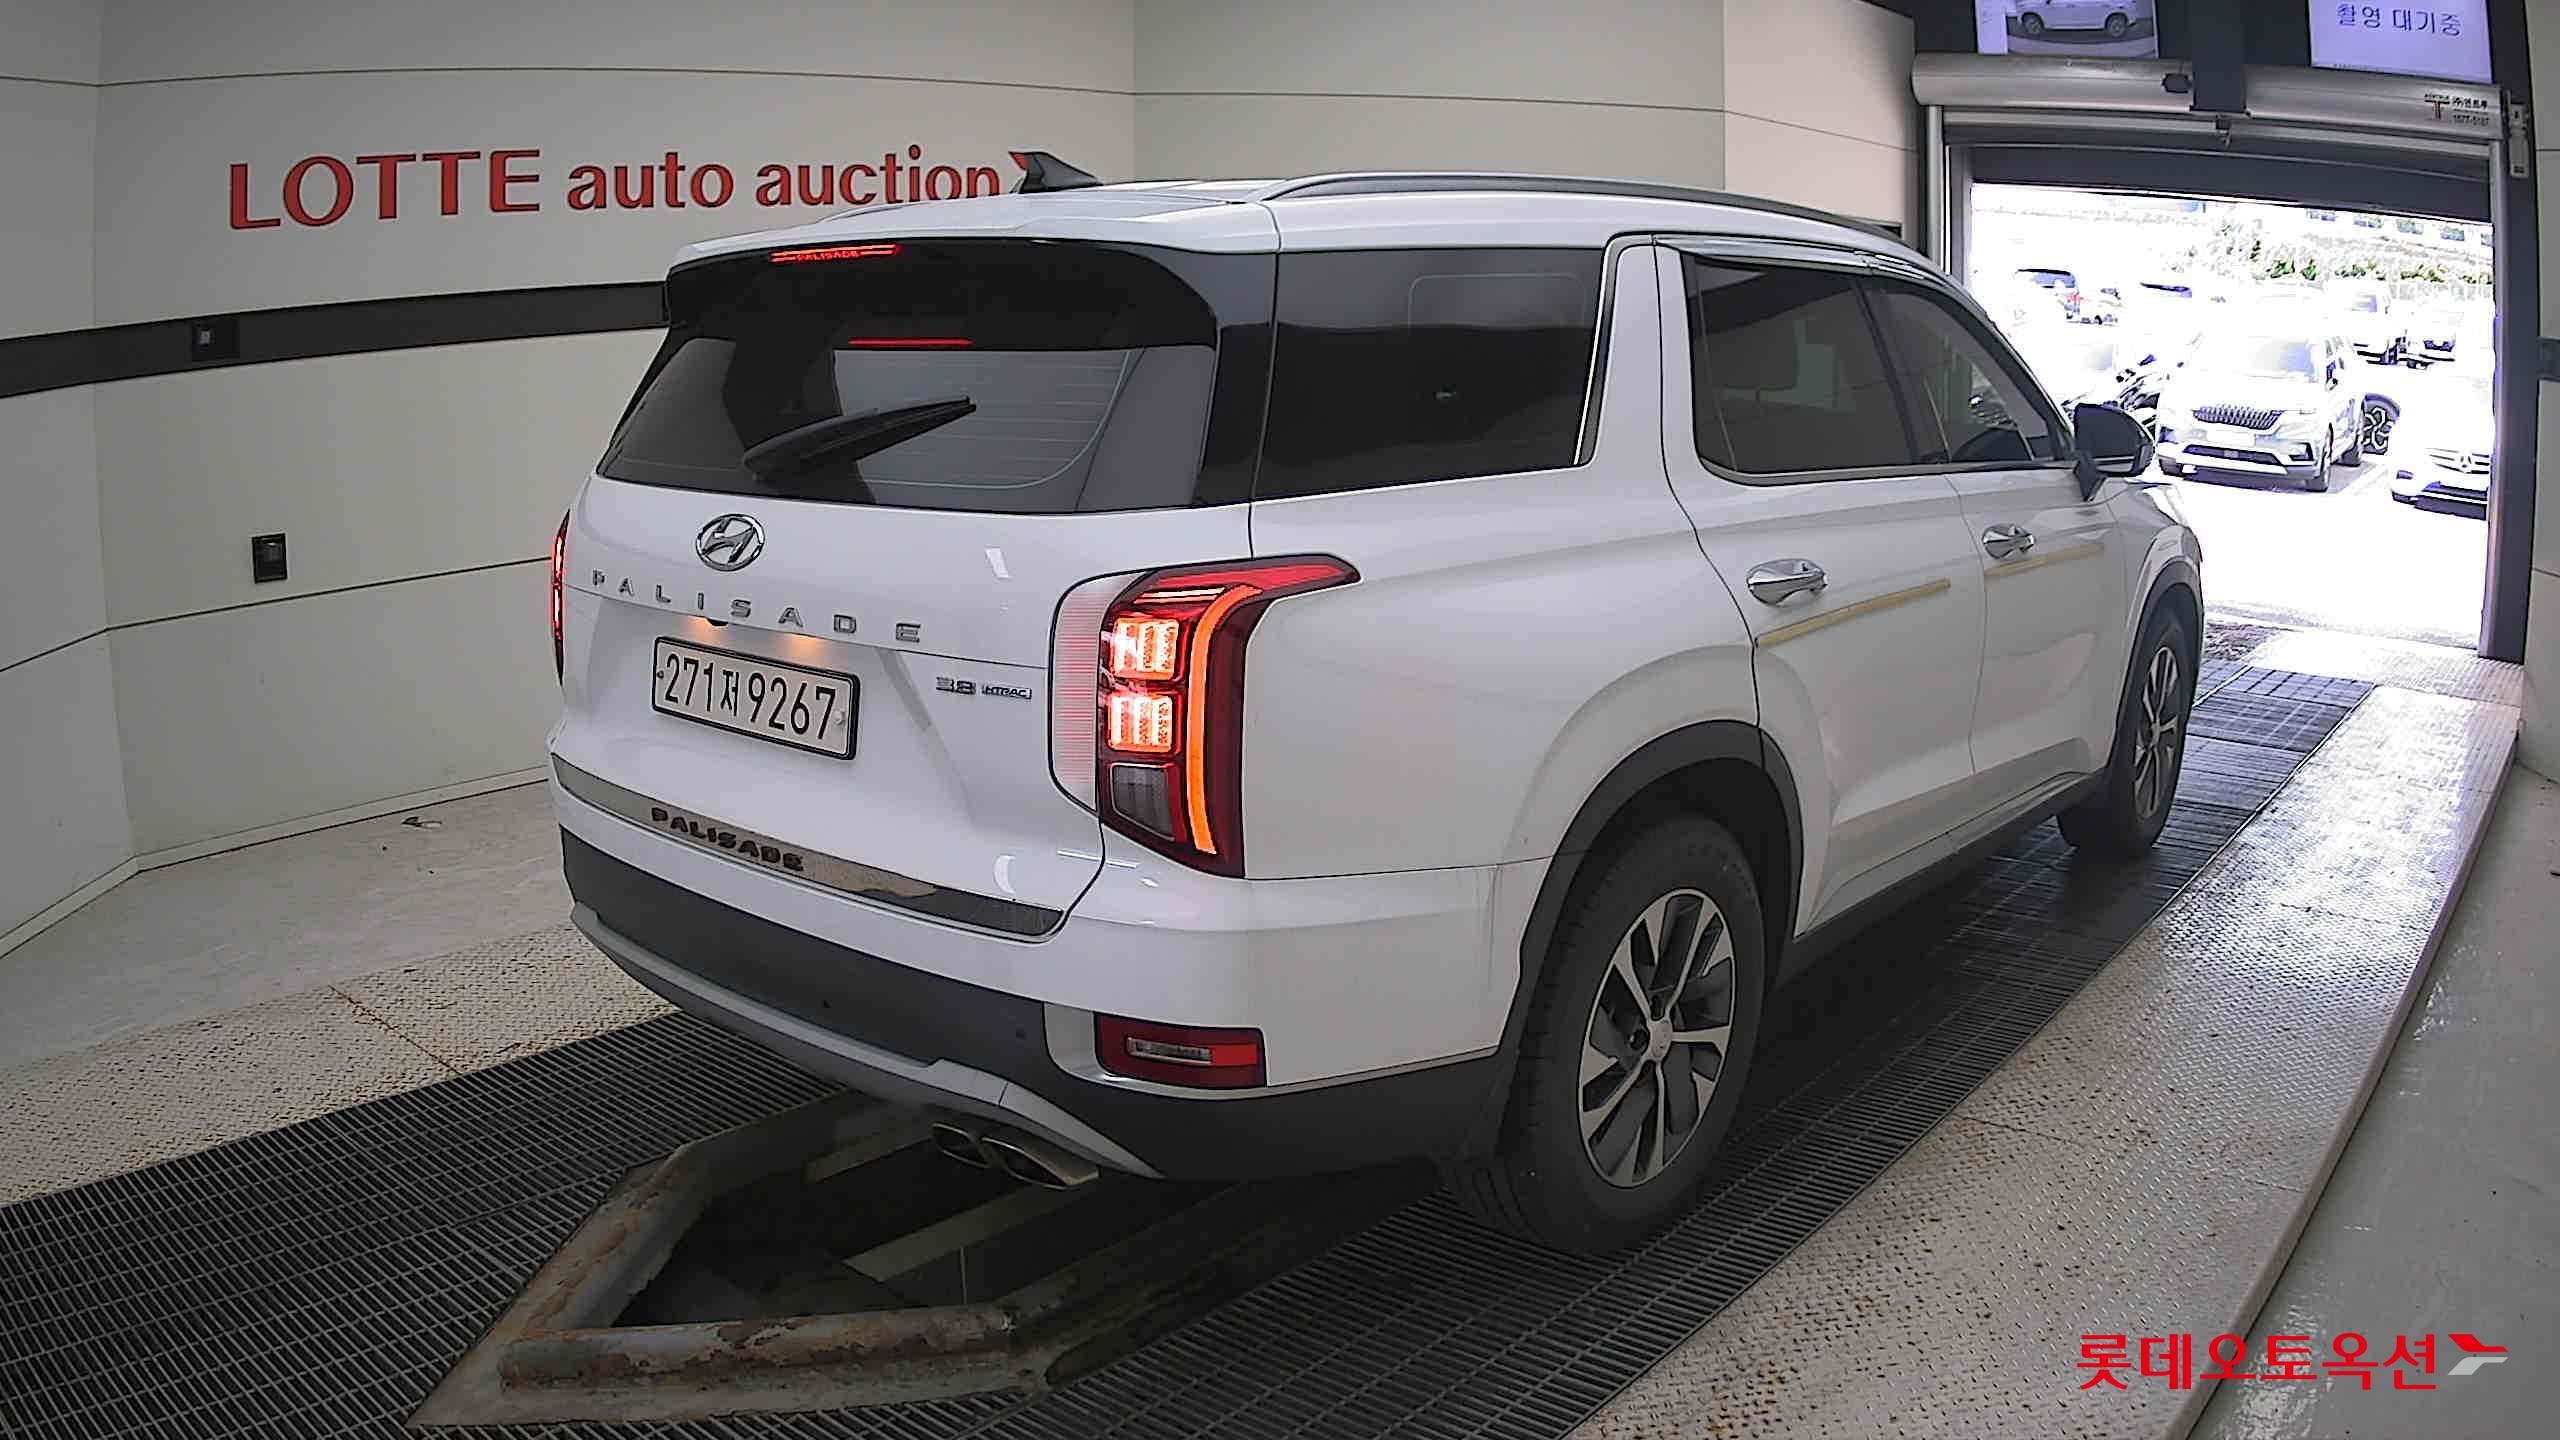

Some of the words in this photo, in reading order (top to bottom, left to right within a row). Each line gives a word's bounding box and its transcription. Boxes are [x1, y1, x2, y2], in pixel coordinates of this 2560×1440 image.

[2337, 3, 2381, 29] 촬영
[2392, 8, 2461, 37] 대기중
[229, 149, 540, 230] LOTTE
[567, 151, 734, 210] auto
[755, 144, 1000, 206] auction
[797, 250, 860, 262] PALISADE
[592, 568, 922, 644] PALISADE
[664, 653, 836, 740] 271저9267
[982, 684, 1031, 700] HTRAC
[651, 806, 804, 872] PALISADE
